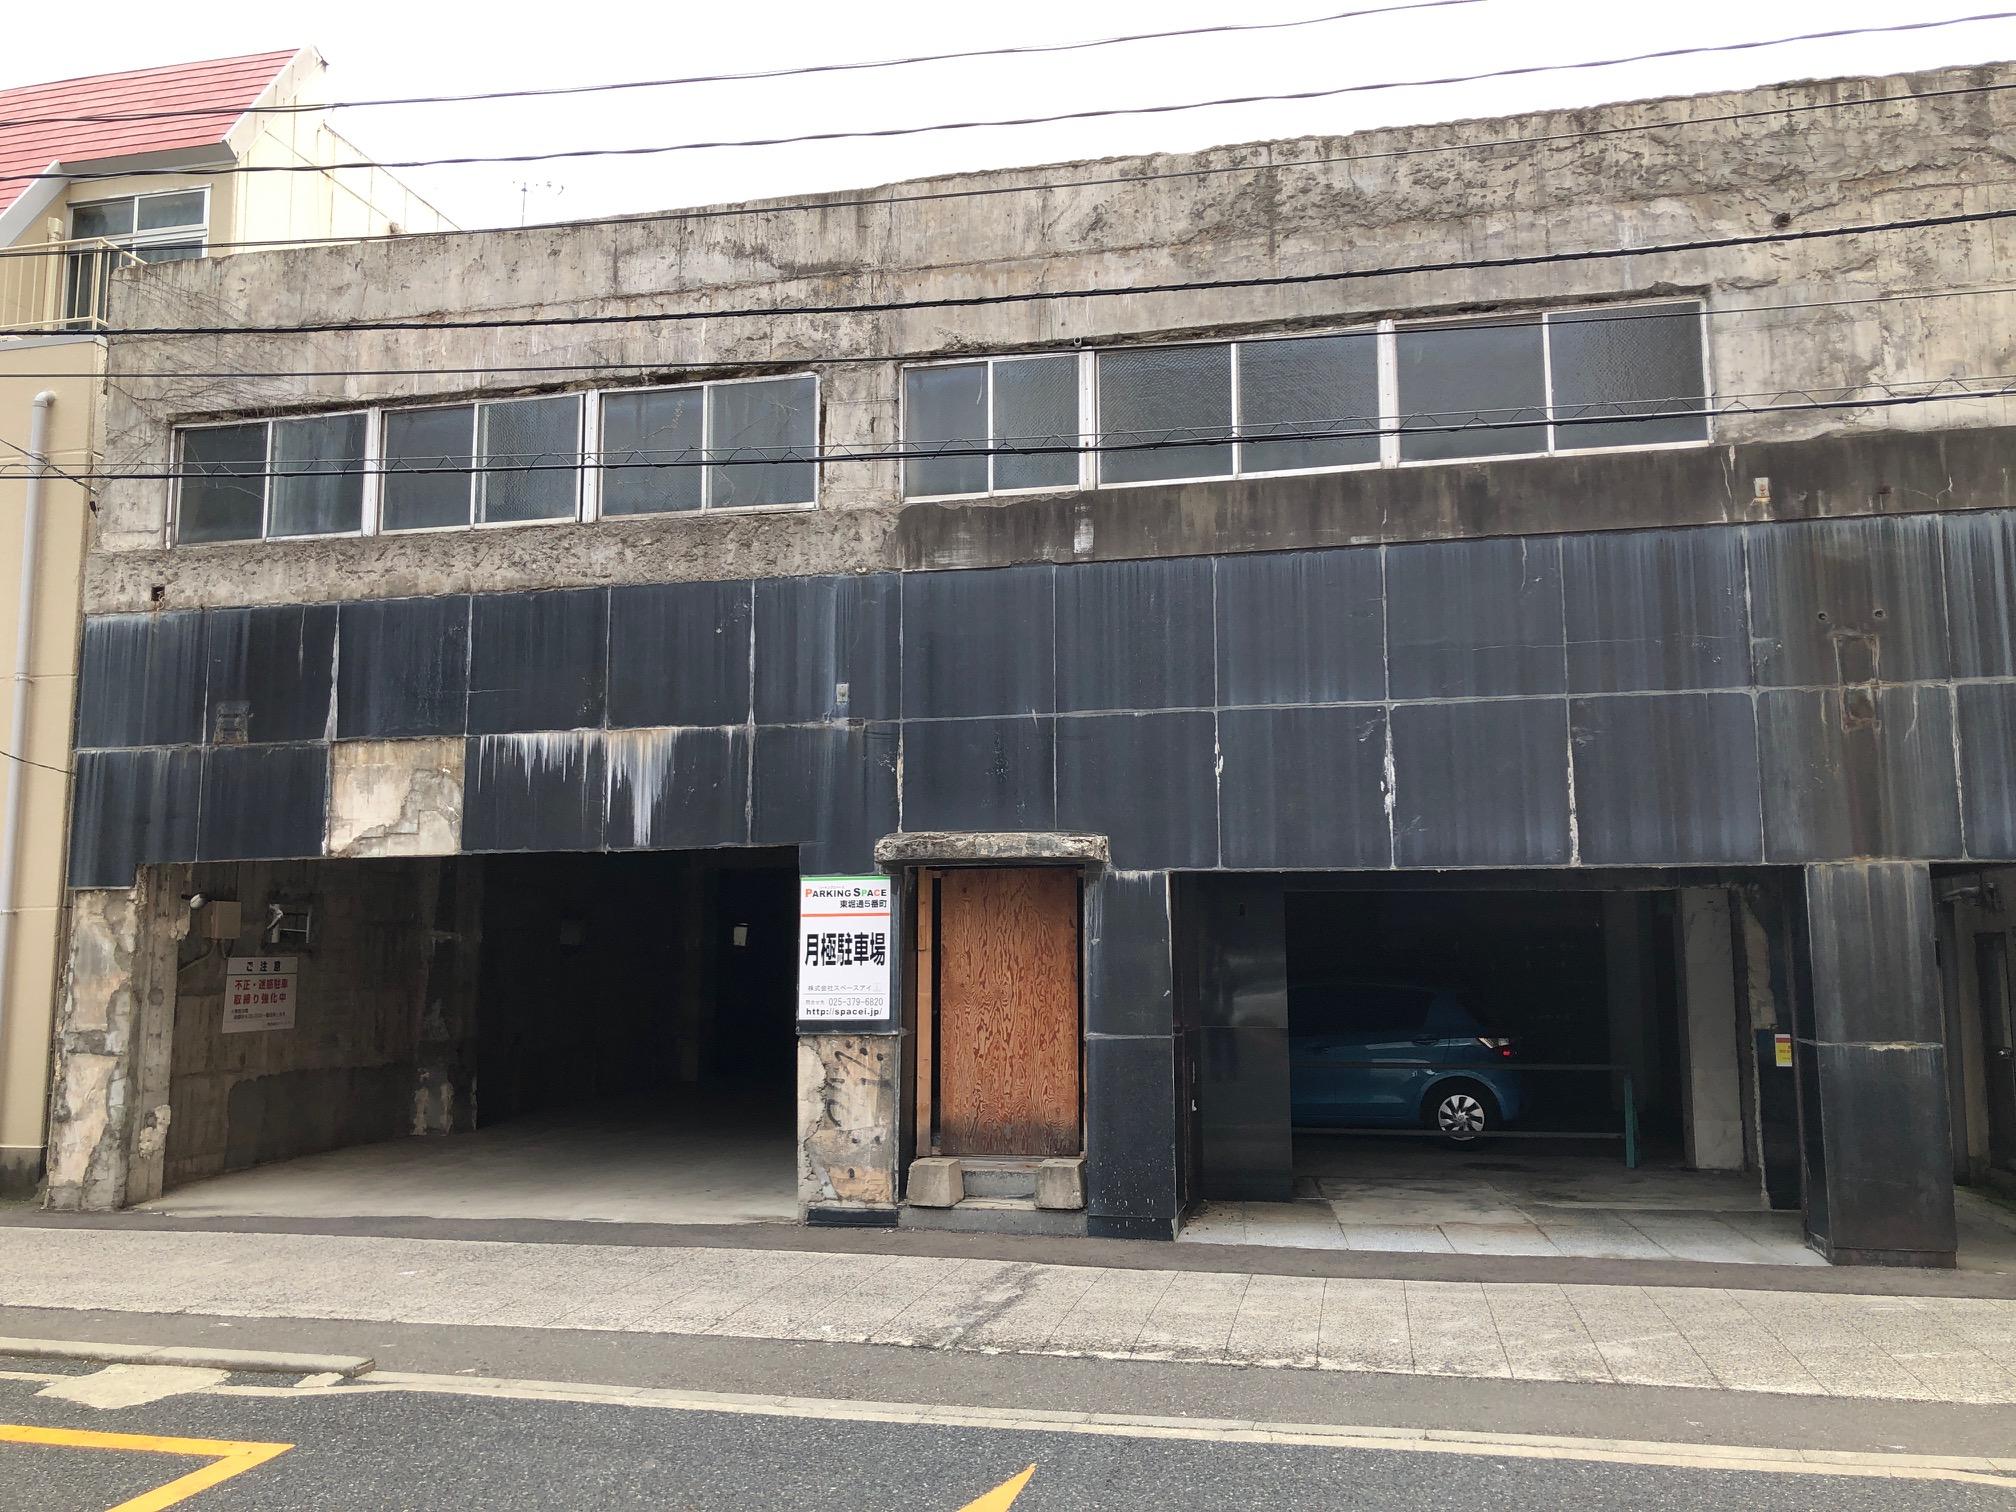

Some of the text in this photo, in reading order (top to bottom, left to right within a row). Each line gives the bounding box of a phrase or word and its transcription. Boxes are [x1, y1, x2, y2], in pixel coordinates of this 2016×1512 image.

[805, 887, 887, 898] PARKING SPACE
[840, 899, 887, 909] 東堀通5番町
[805, 931, 887, 967] 月極駐車場
[246, 960, 281, 972] ご注意
[806, 1007, 883, 1017] http://spacei.jp/
